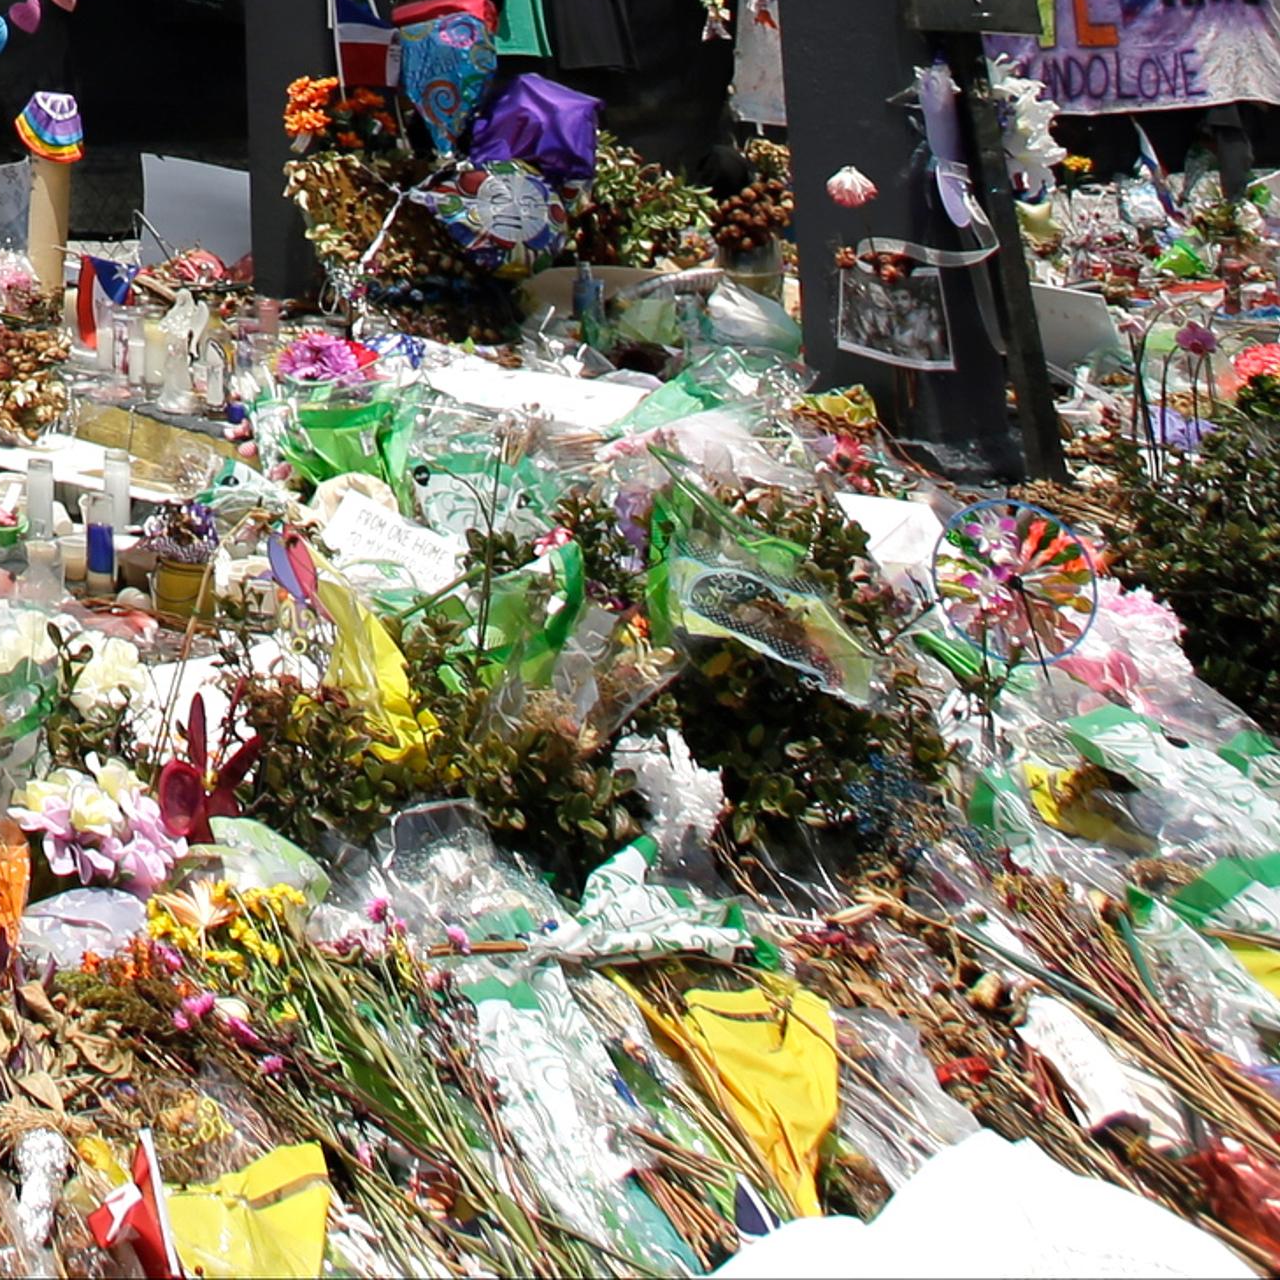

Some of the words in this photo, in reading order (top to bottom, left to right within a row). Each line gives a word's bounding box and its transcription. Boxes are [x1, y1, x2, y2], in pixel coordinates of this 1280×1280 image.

[1115, 49, 1206, 100] LOVE
[357, 508, 387, 531] FROM
[387, 524, 413, 547] ONE
[411, 536, 450, 565] HOME
